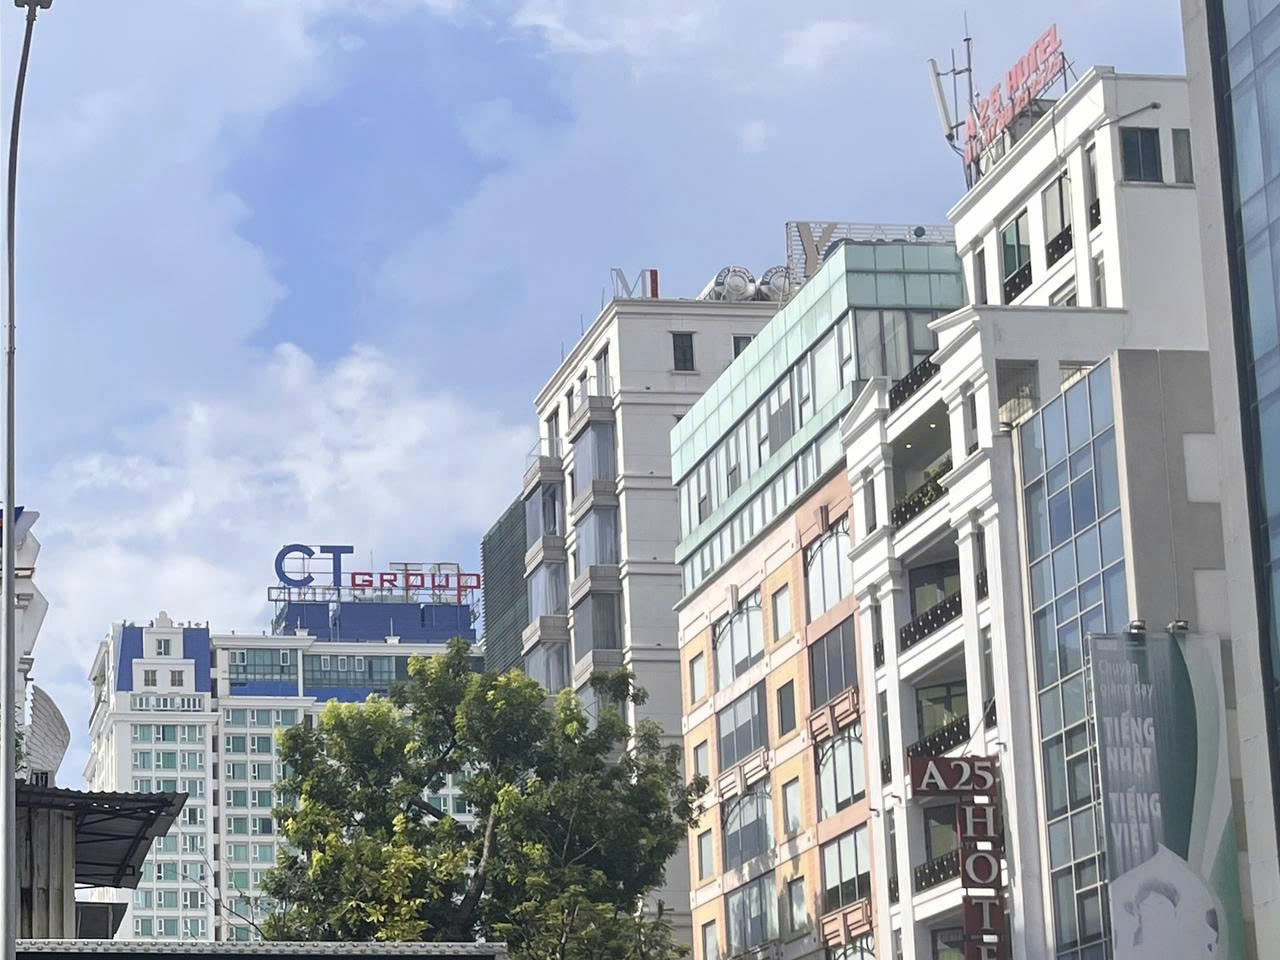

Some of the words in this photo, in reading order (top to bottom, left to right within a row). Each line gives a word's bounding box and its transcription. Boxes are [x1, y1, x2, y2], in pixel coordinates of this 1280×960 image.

[275, 544, 354, 587] CT
[351, 572, 481, 604] GROUP
[917, 760, 994, 791] A25
